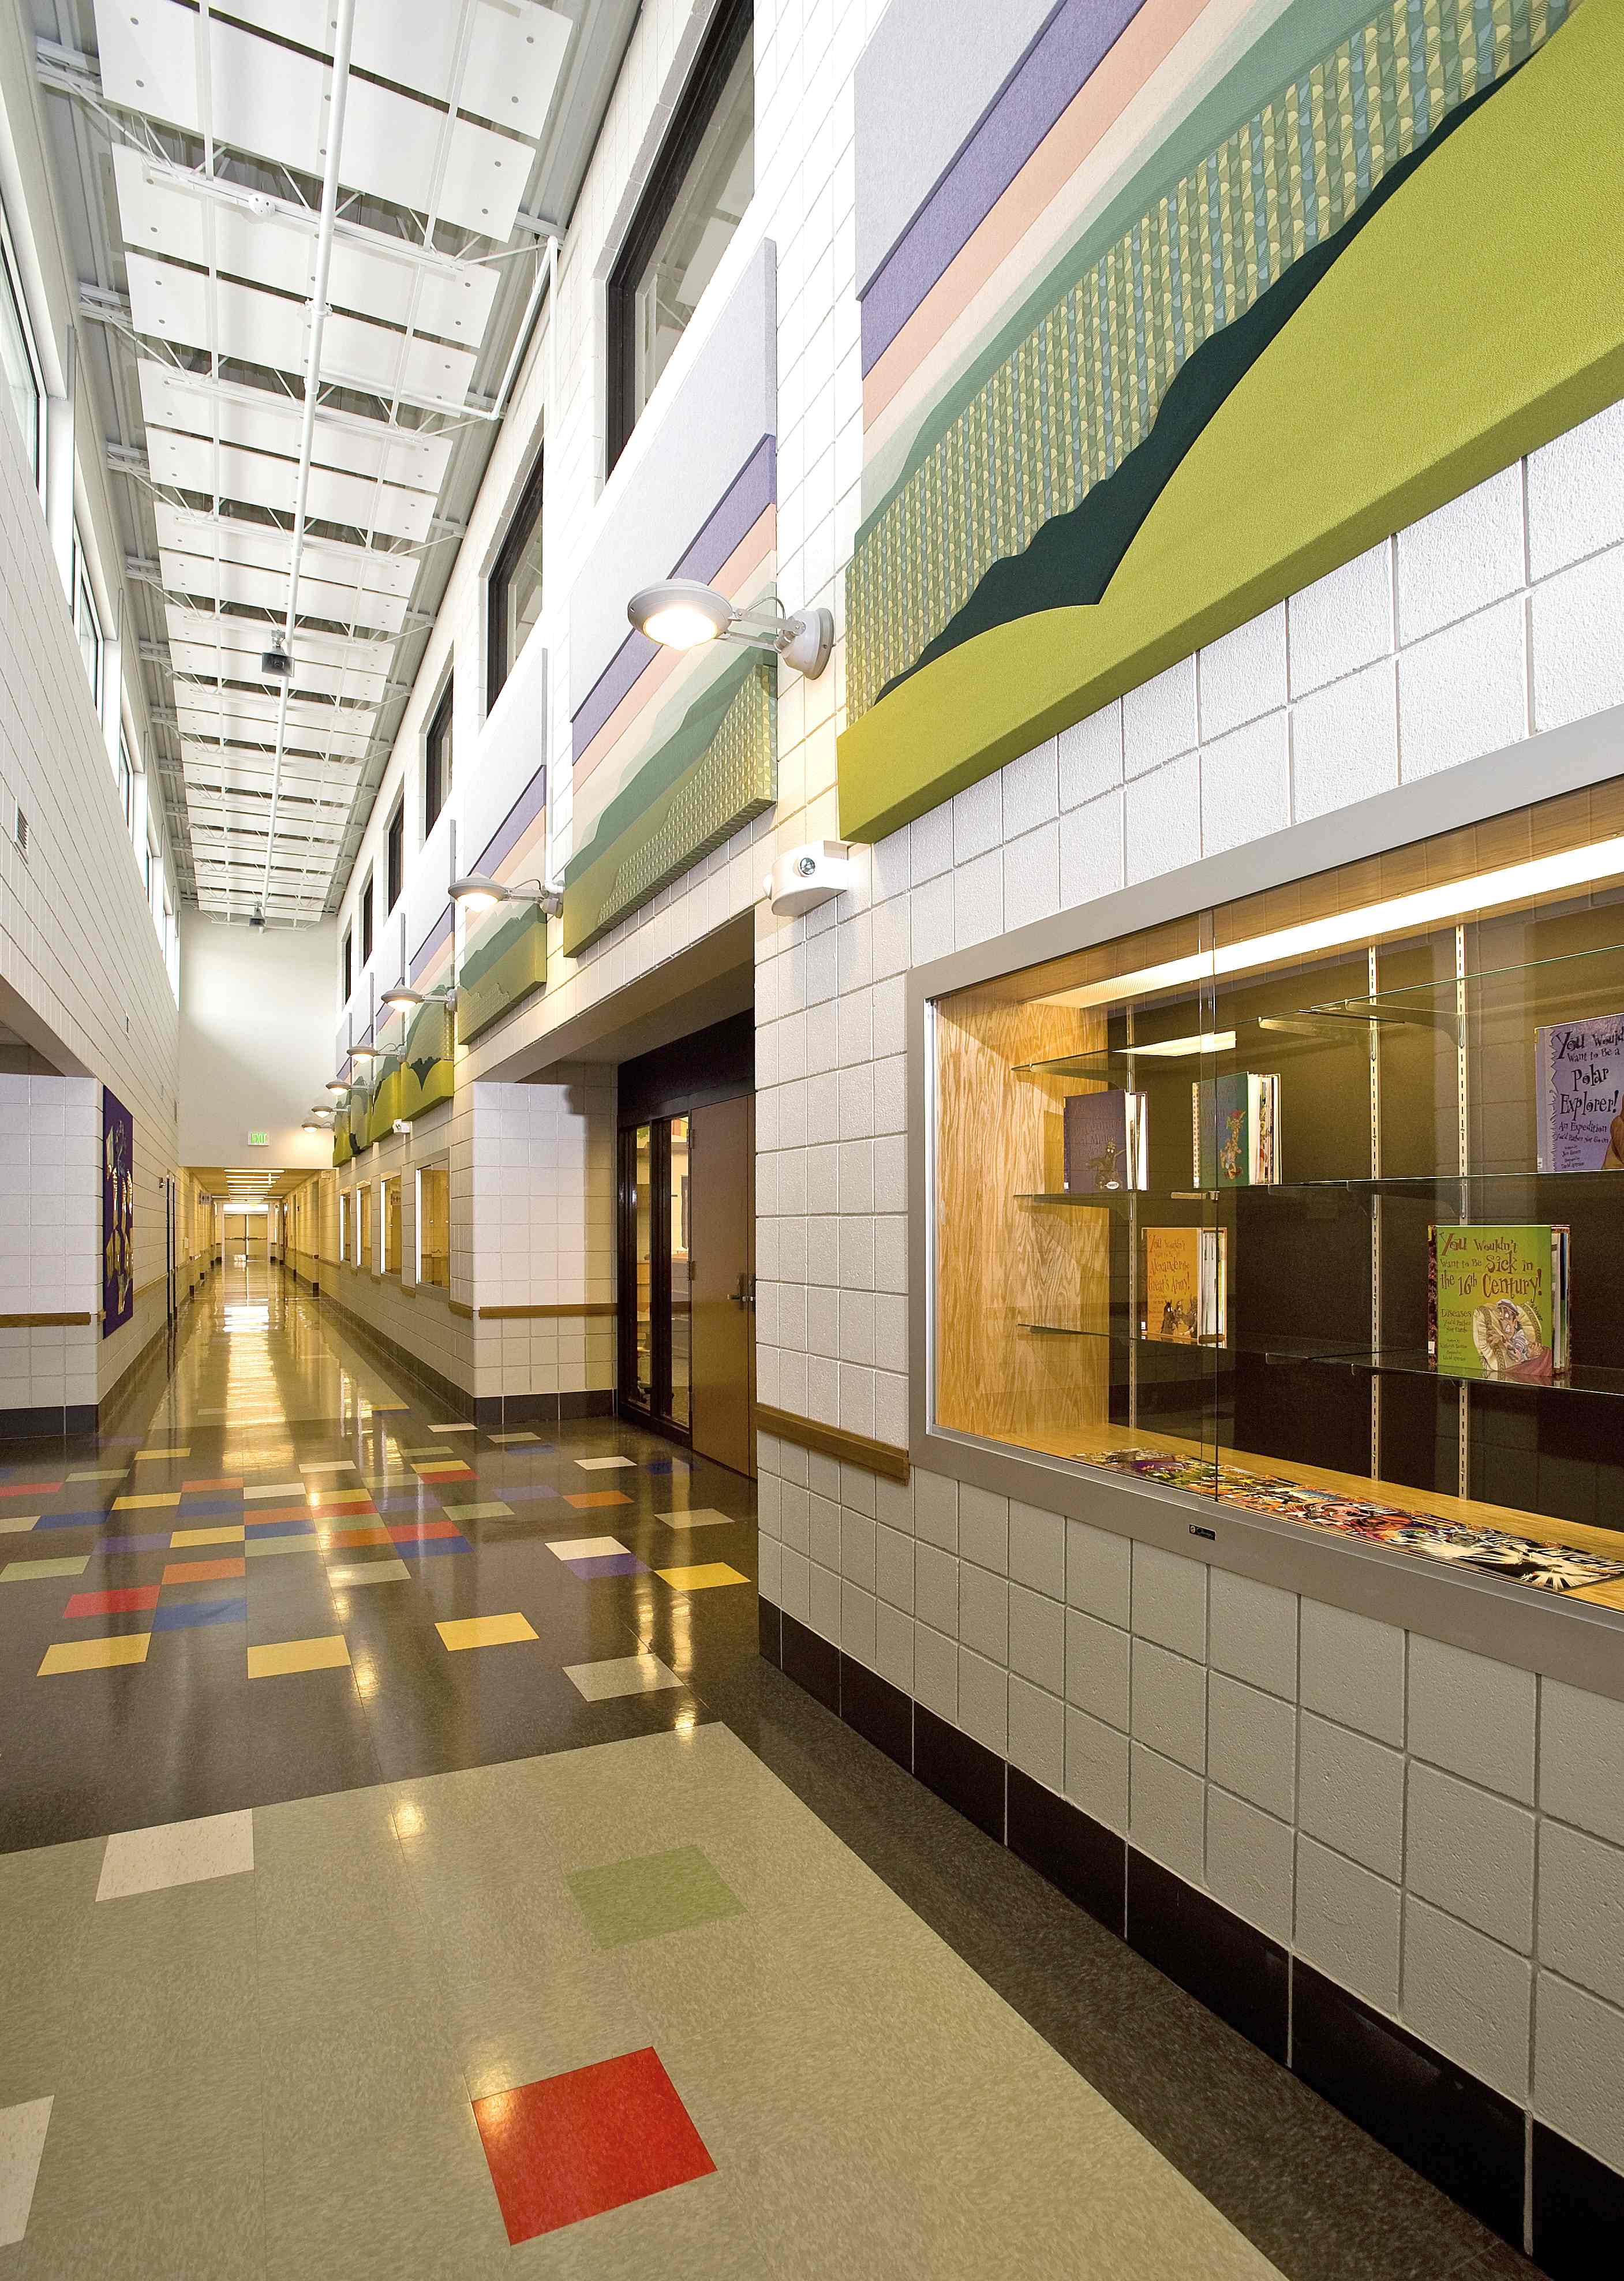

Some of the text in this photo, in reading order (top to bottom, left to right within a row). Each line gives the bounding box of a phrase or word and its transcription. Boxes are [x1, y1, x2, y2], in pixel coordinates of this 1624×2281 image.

[1555, 1031, 1585, 1060] You
[1566, 1048, 1621, 1063] Want to Be a
[1571, 1064, 1609, 1092] Polar
[1560, 1090, 1619, 1121] Explorer!
[250, 1132, 268, 1143] EXIT
[1559, 1120, 1607, 1134] An Expedition
[1148, 1234, 1162, 1252] You
[1439, 1232, 1518, 1257] You Wouldn't
[1150, 1257, 1182, 1275] Alexander
[1440, 1251, 1533, 1274] Want to Be Sick in
[1148, 1272, 1190, 1295] Great's Army!
[1440, 1269, 1542, 1303] the 16th Century!
[1441, 1308, 1472, 1317] Diseases
